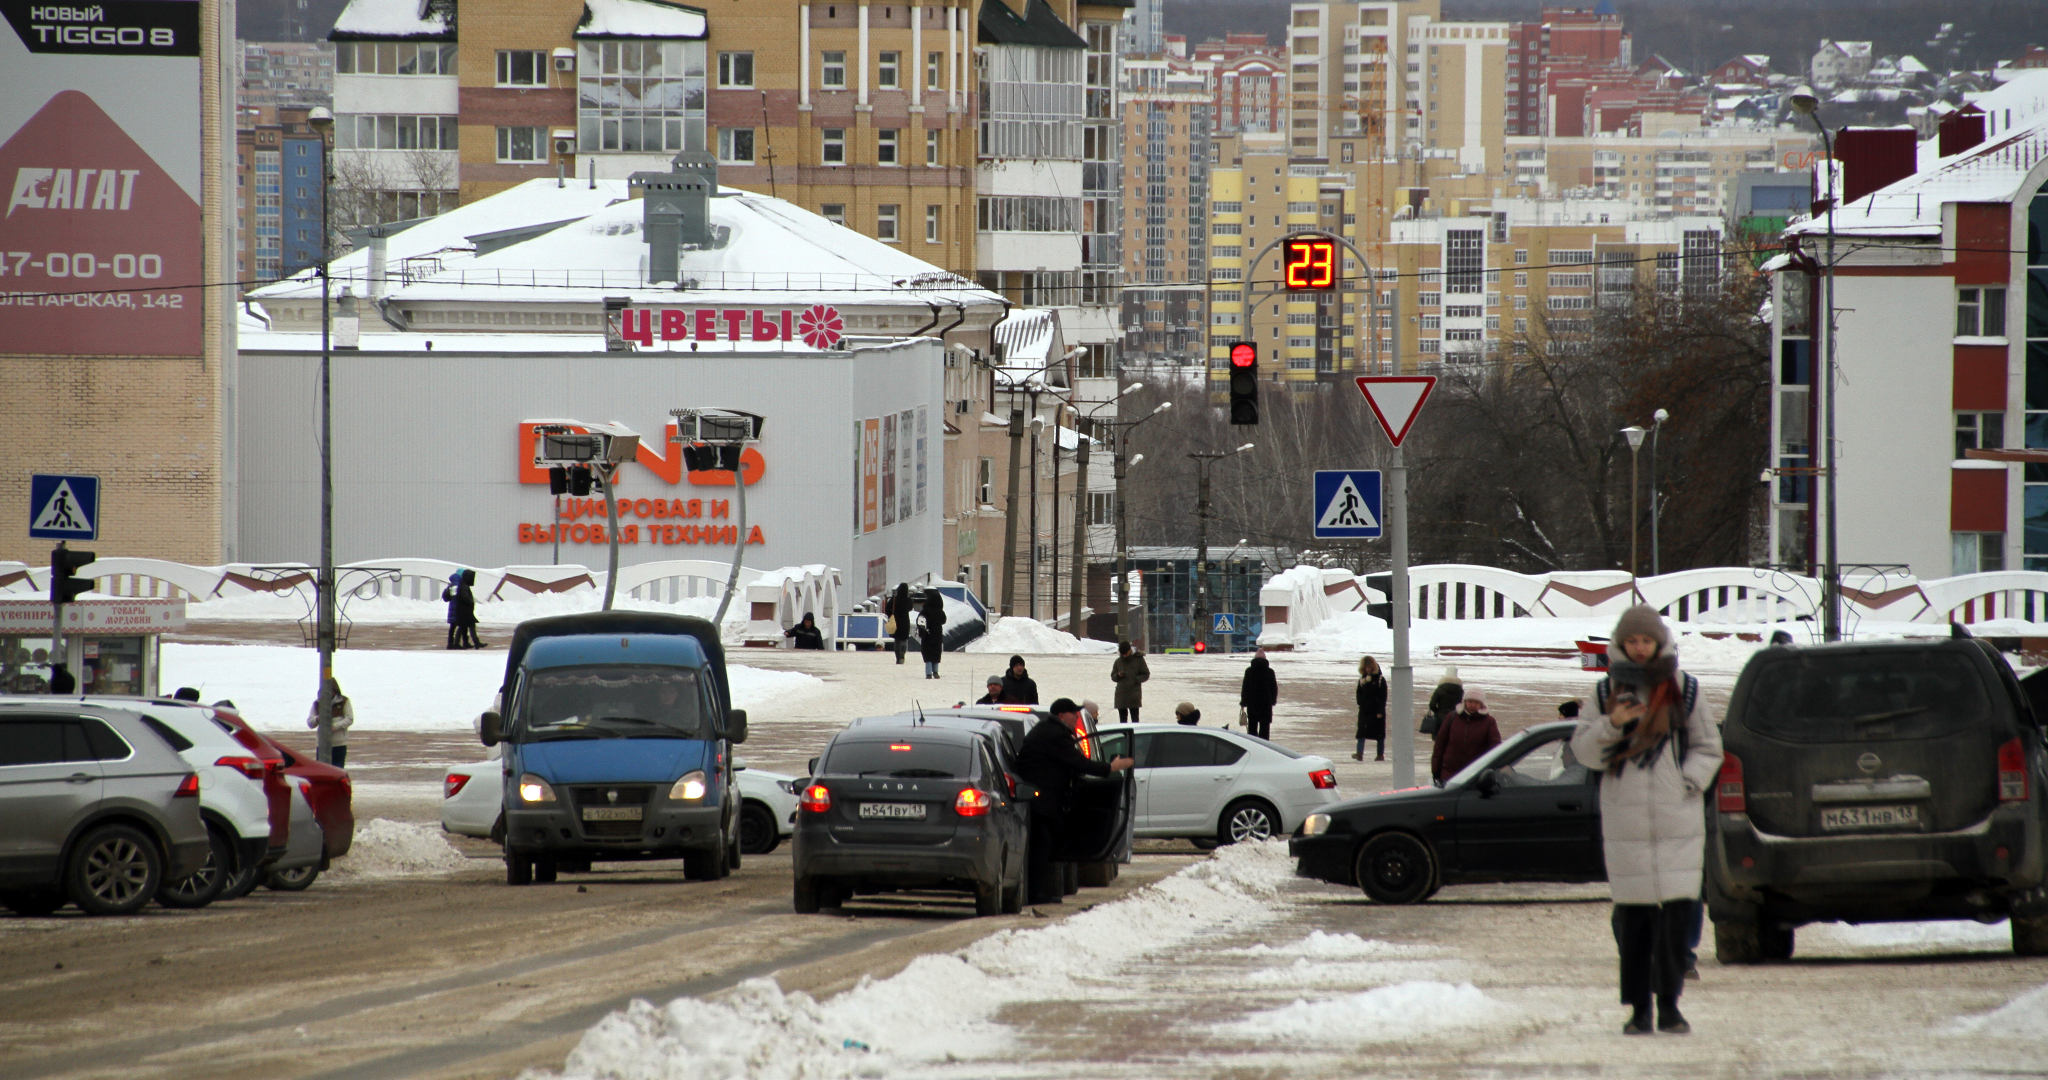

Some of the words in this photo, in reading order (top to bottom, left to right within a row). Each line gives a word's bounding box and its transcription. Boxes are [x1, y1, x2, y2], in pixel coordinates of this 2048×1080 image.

[32, 6, 103, 21] НОВЫЙ
[32, 25, 144, 44] TIGGO
[150, 28, 174, 46] 8
[1287, 243, 1333, 286] 23
[142, 293, 183, 309] 142
[622, 309, 792, 347] ЦВЕТЫ
[711, 498, 730, 519] И
[111, 606, 146, 615] ТОВАРЫ
[105, 616, 151, 625] МОРДОВИИ
[868, 783, 918, 791] LADA
